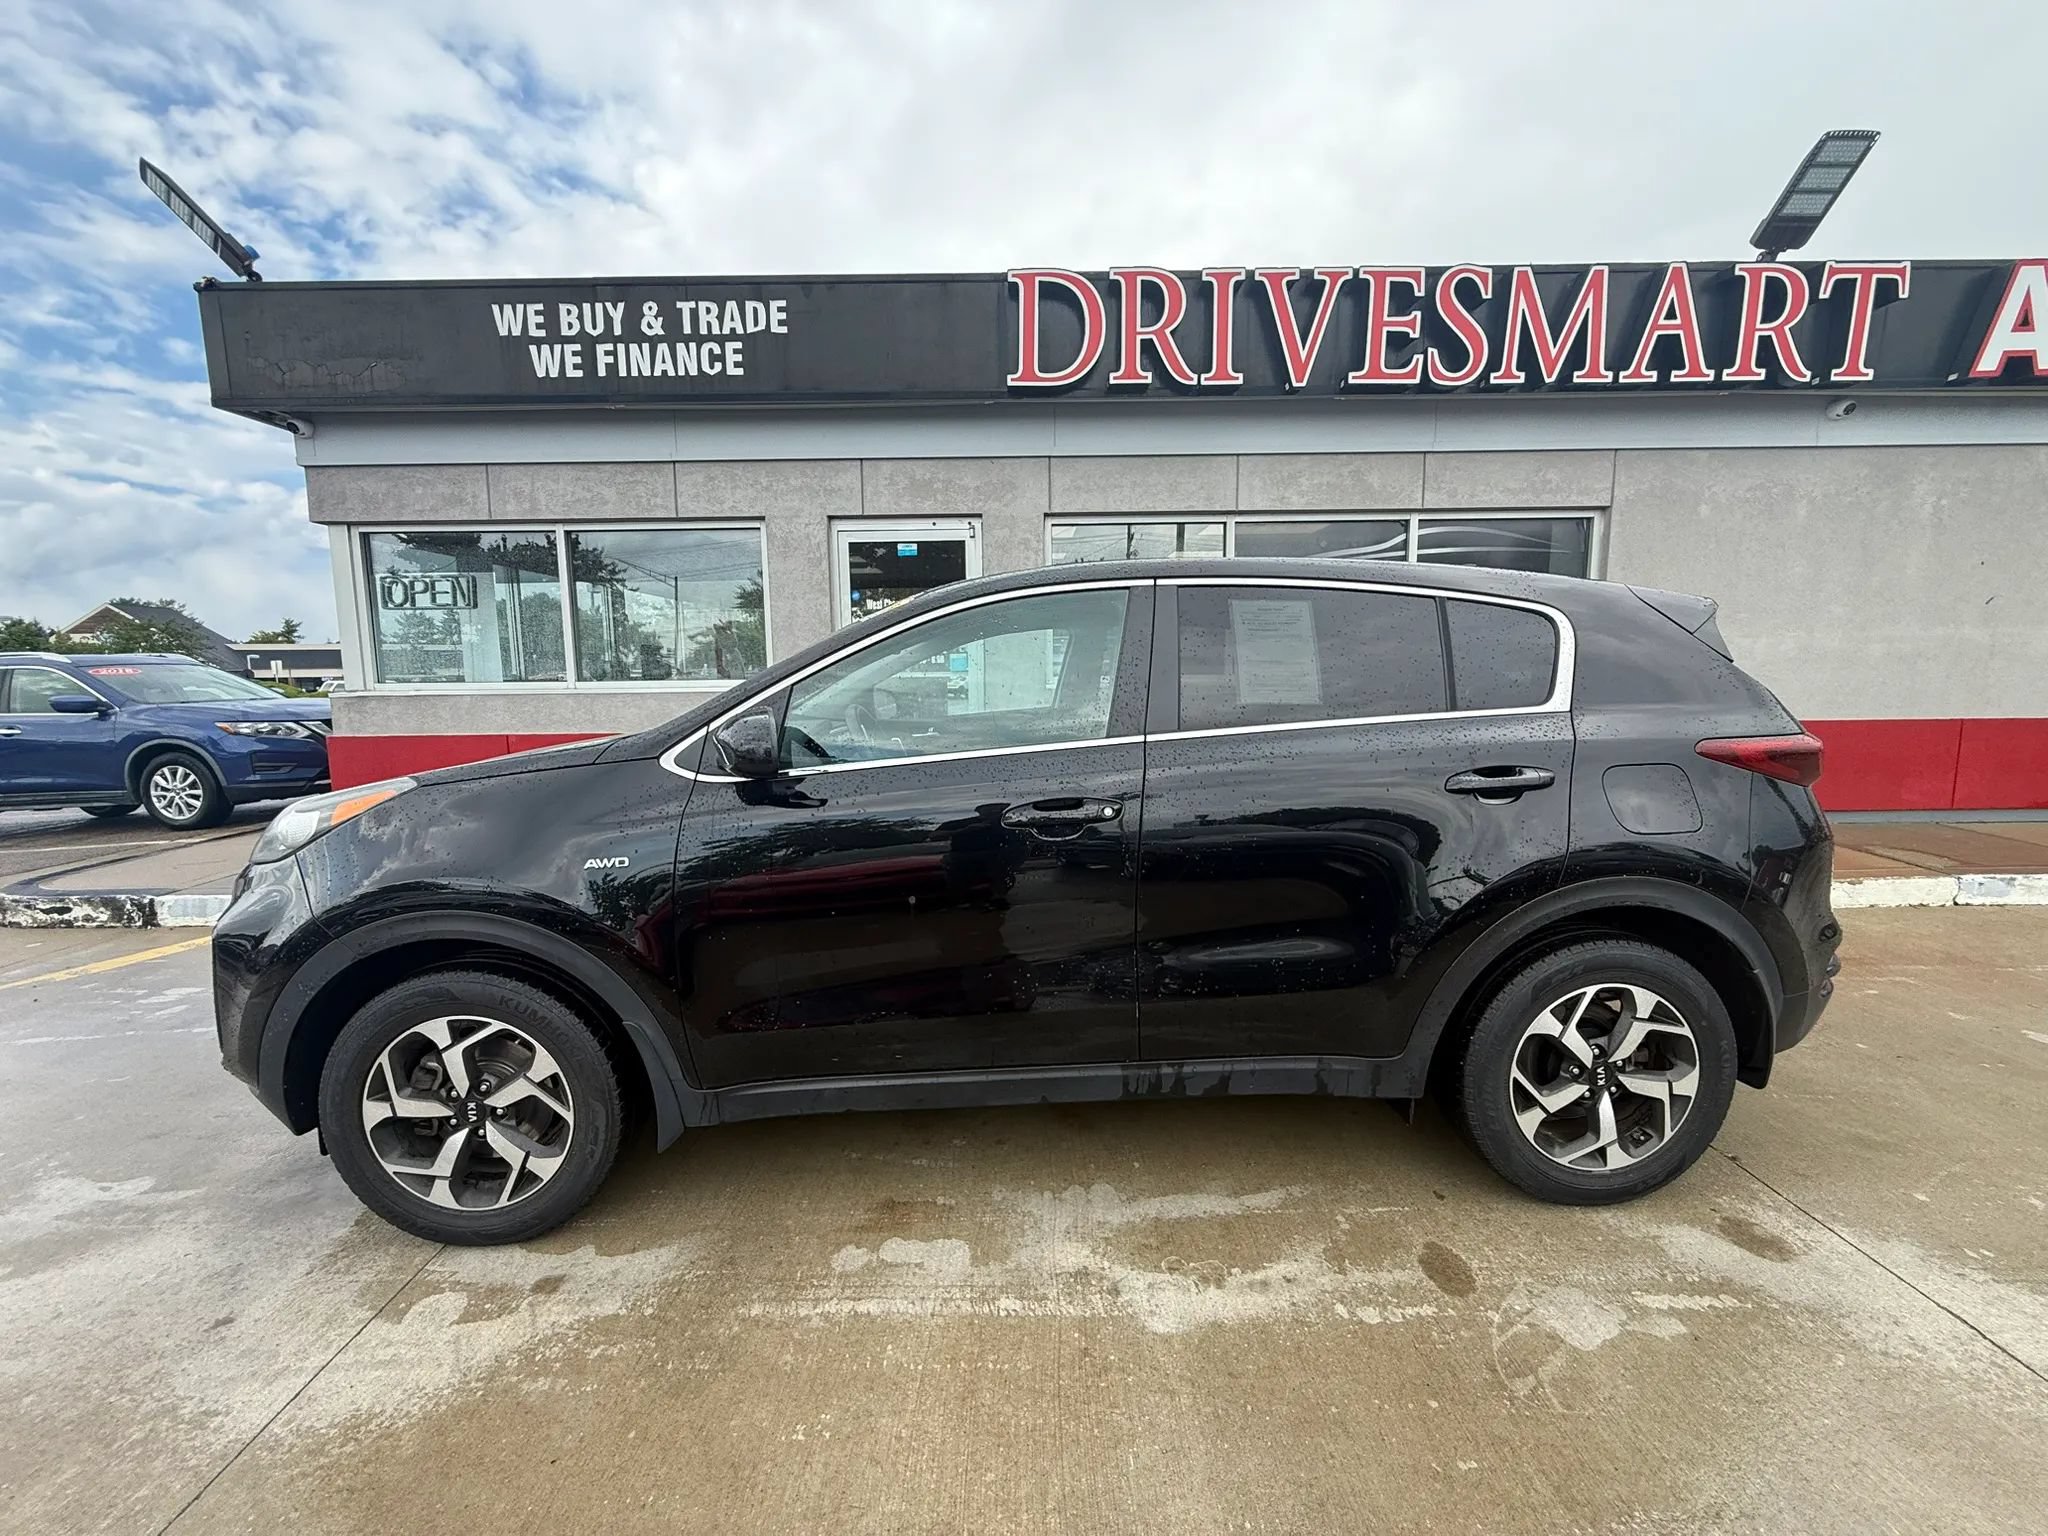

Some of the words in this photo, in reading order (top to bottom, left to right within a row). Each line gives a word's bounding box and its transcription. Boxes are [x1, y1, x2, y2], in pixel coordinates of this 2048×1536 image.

[491, 303, 546, 337] WE
[558, 301, 625, 338] BUY
[640, 300, 664, 336] &
[676, 300, 788, 335] TRADE
[1006, 261, 1912, 389] DRIVESMART
[528, 343, 584, 378] WE
[596, 341, 744, 377] FINANCE
[384, 579, 473, 608] OPEN
[583, 856, 630, 870] AWD
[1596, 1066, 1606, 1086] KIA
[467, 1102, 477, 1122] KIA
